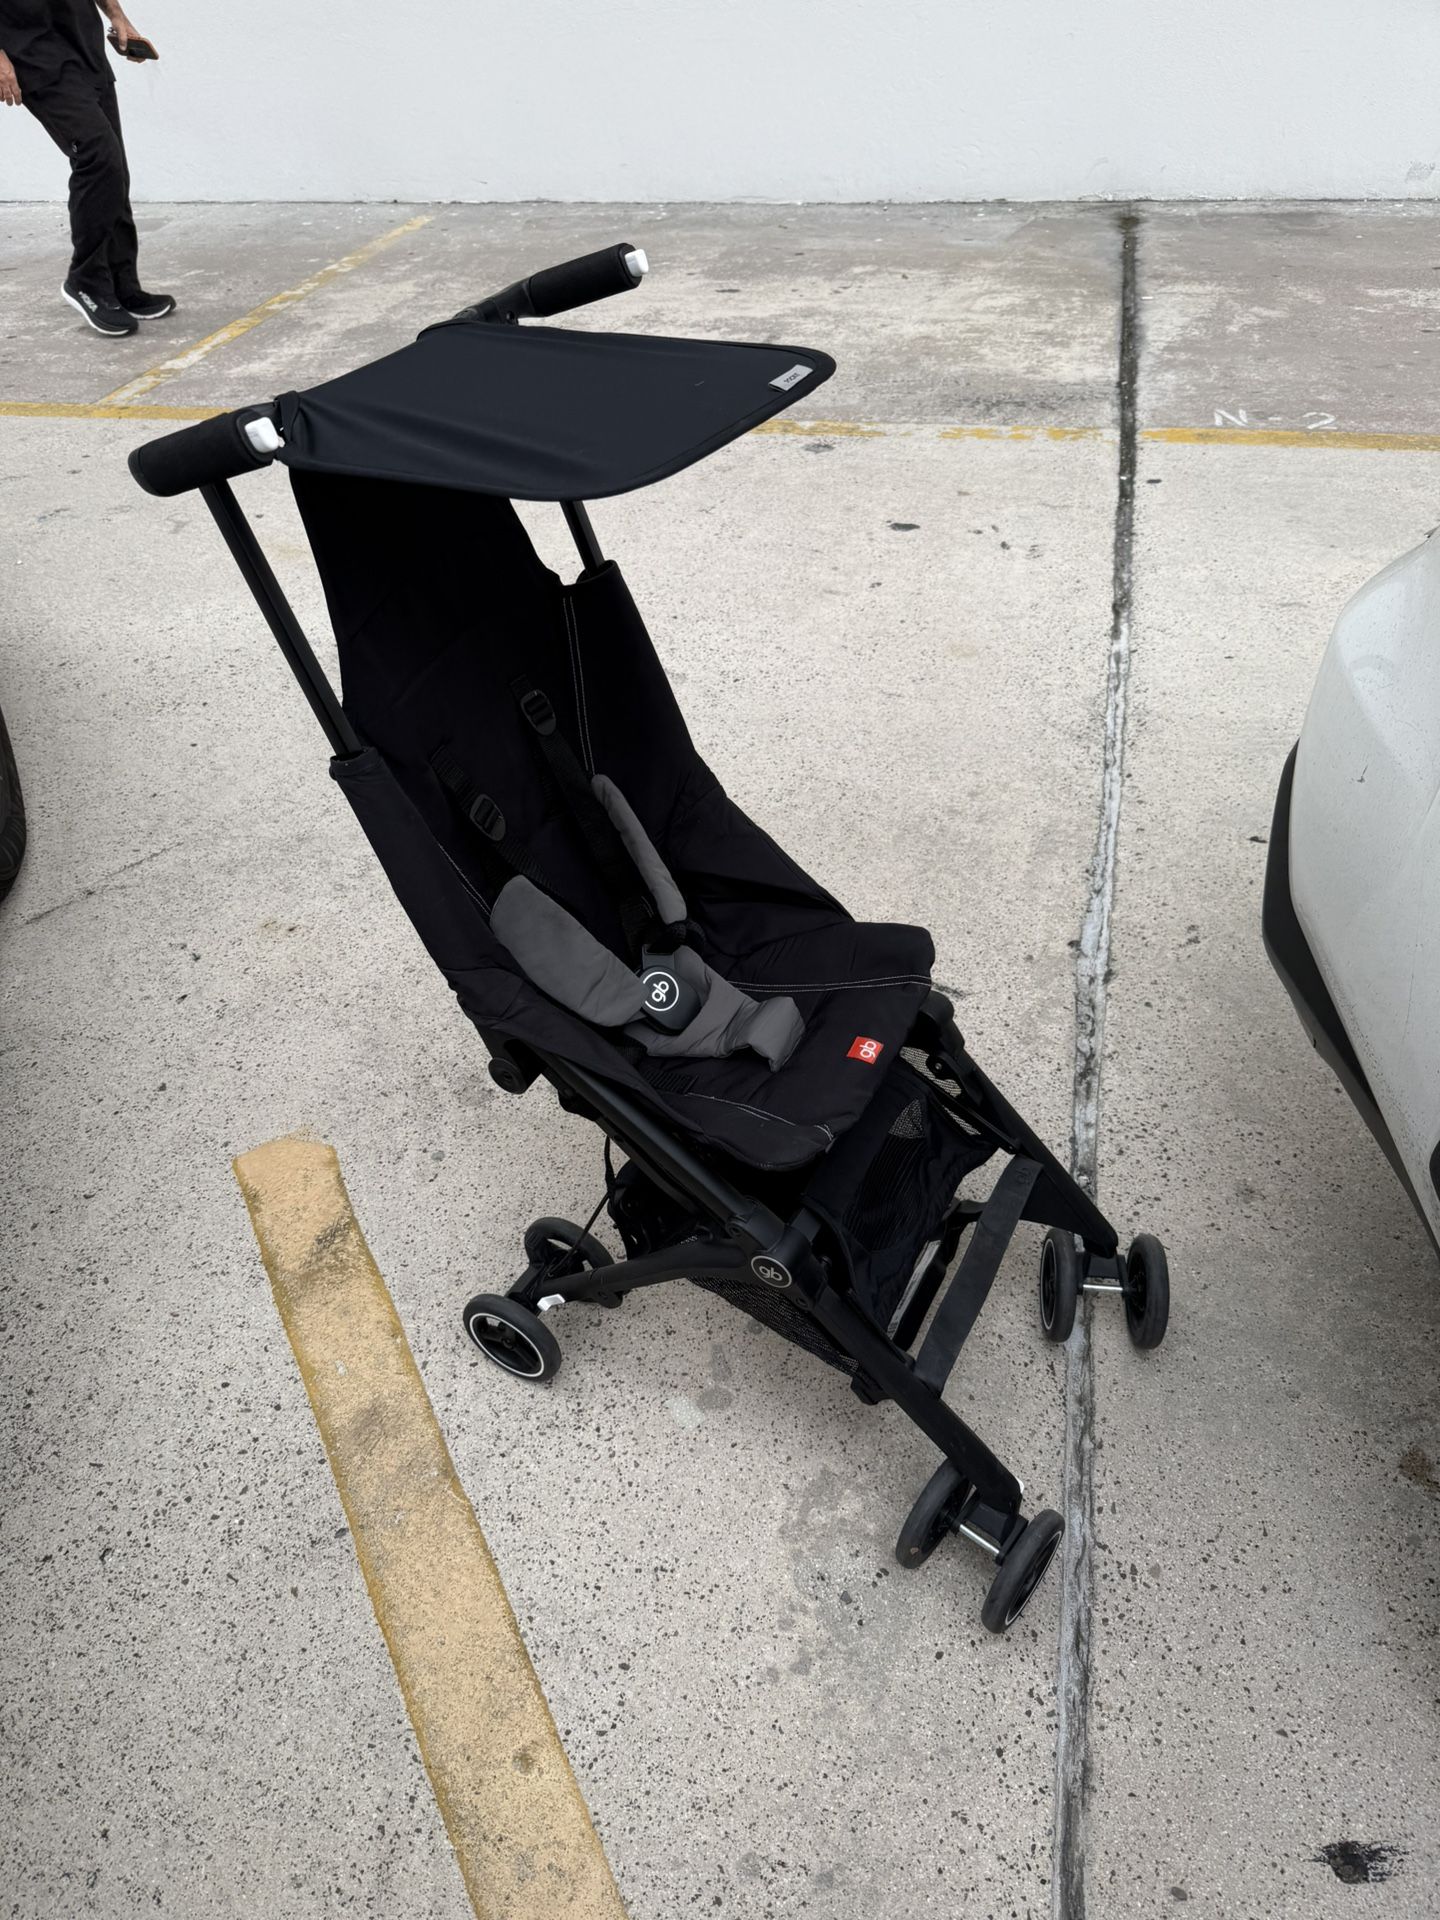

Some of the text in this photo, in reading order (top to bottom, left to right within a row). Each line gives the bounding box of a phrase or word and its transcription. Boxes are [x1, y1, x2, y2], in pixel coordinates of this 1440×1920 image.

[652, 981, 669, 1003] gb
[859, 1041, 877, 1058] gb
[759, 1265, 783, 1281] gb
